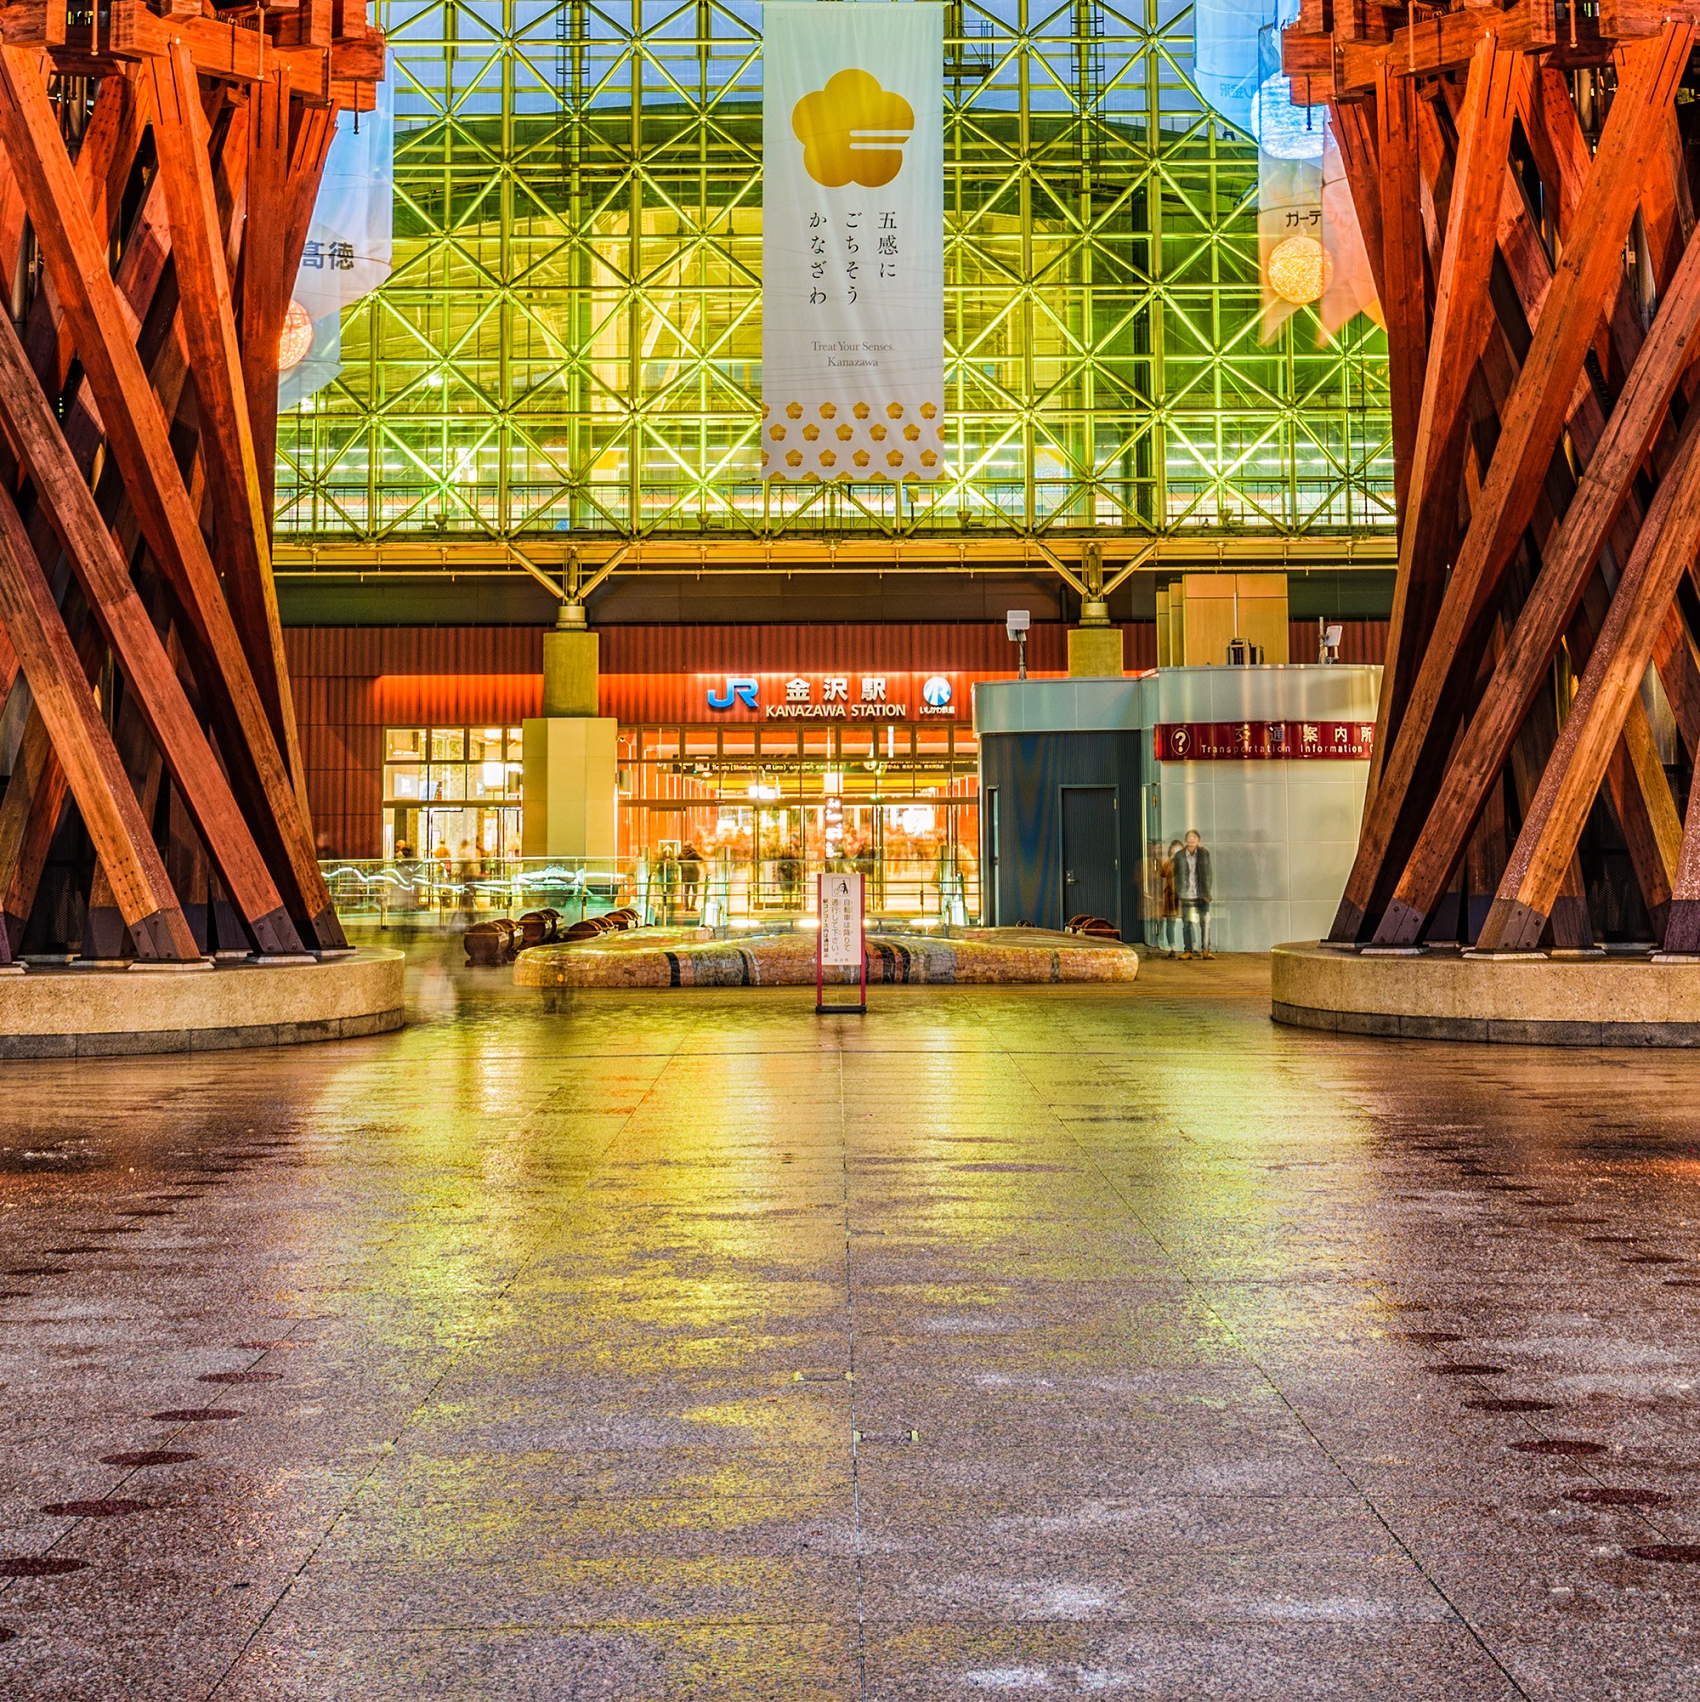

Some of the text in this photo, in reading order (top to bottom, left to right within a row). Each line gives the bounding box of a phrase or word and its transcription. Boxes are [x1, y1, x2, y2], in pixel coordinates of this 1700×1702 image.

[877, 210, 899, 278] 五感に
[809, 212, 827, 305] かなざわ
[845, 212, 863, 305] ごちそう
[811, 341, 894, 351] Treat Your Senses.
[827, 356, 879, 367] Kanazawa
[707, 678, 759, 708] JR
[785, 677, 886, 701] 金沢駅
[765, 704, 906, 717] KANAZAWA STATION
[1235, 726, 1372, 743] 交通案内所
[1201, 744, 1291, 755] Transportation
[1300, 744, 1362, 753] Information
[843, 898, 851, 952] 自転車は降りて
